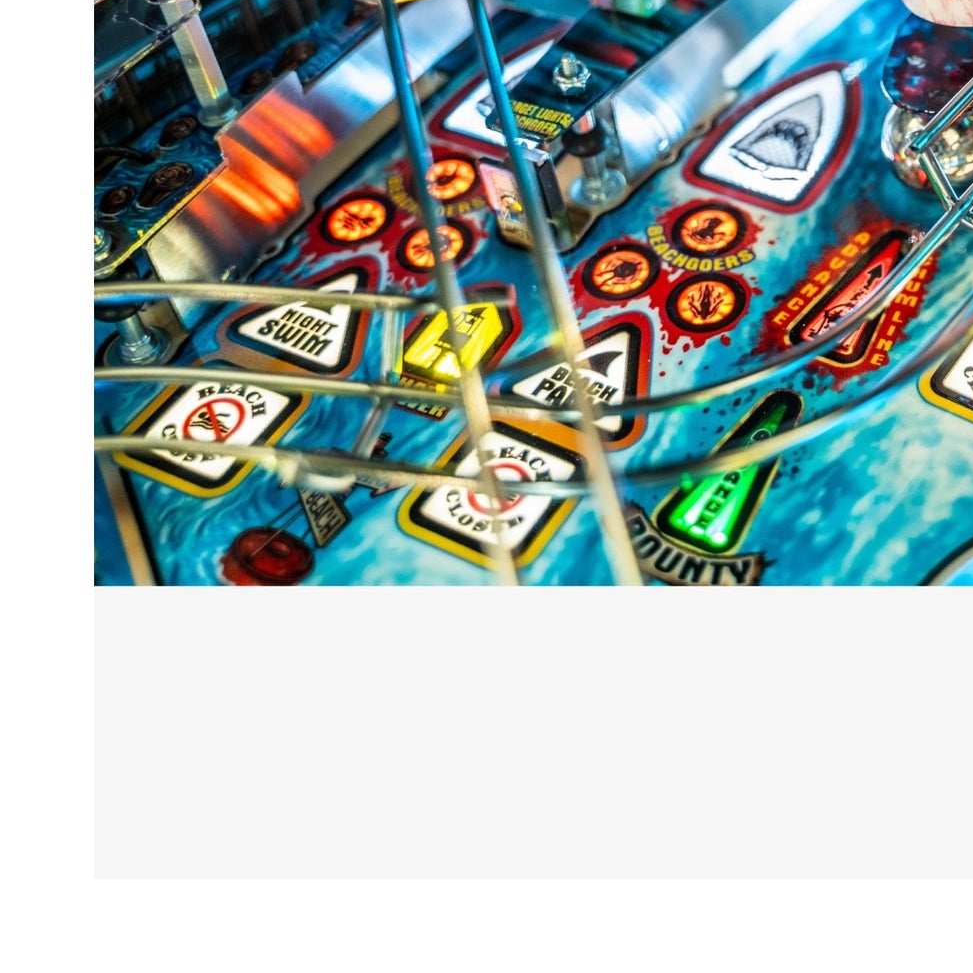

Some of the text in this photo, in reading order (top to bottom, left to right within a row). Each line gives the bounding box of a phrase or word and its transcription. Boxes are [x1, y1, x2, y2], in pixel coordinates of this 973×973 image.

[646, 225, 754, 272] BEACHGOERS
[257, 319, 334, 357] SWIM
[280, 308, 339, 336] NIGHT
[870, 310, 904, 367] LINE
[197, 384, 268, 418] BEACH
